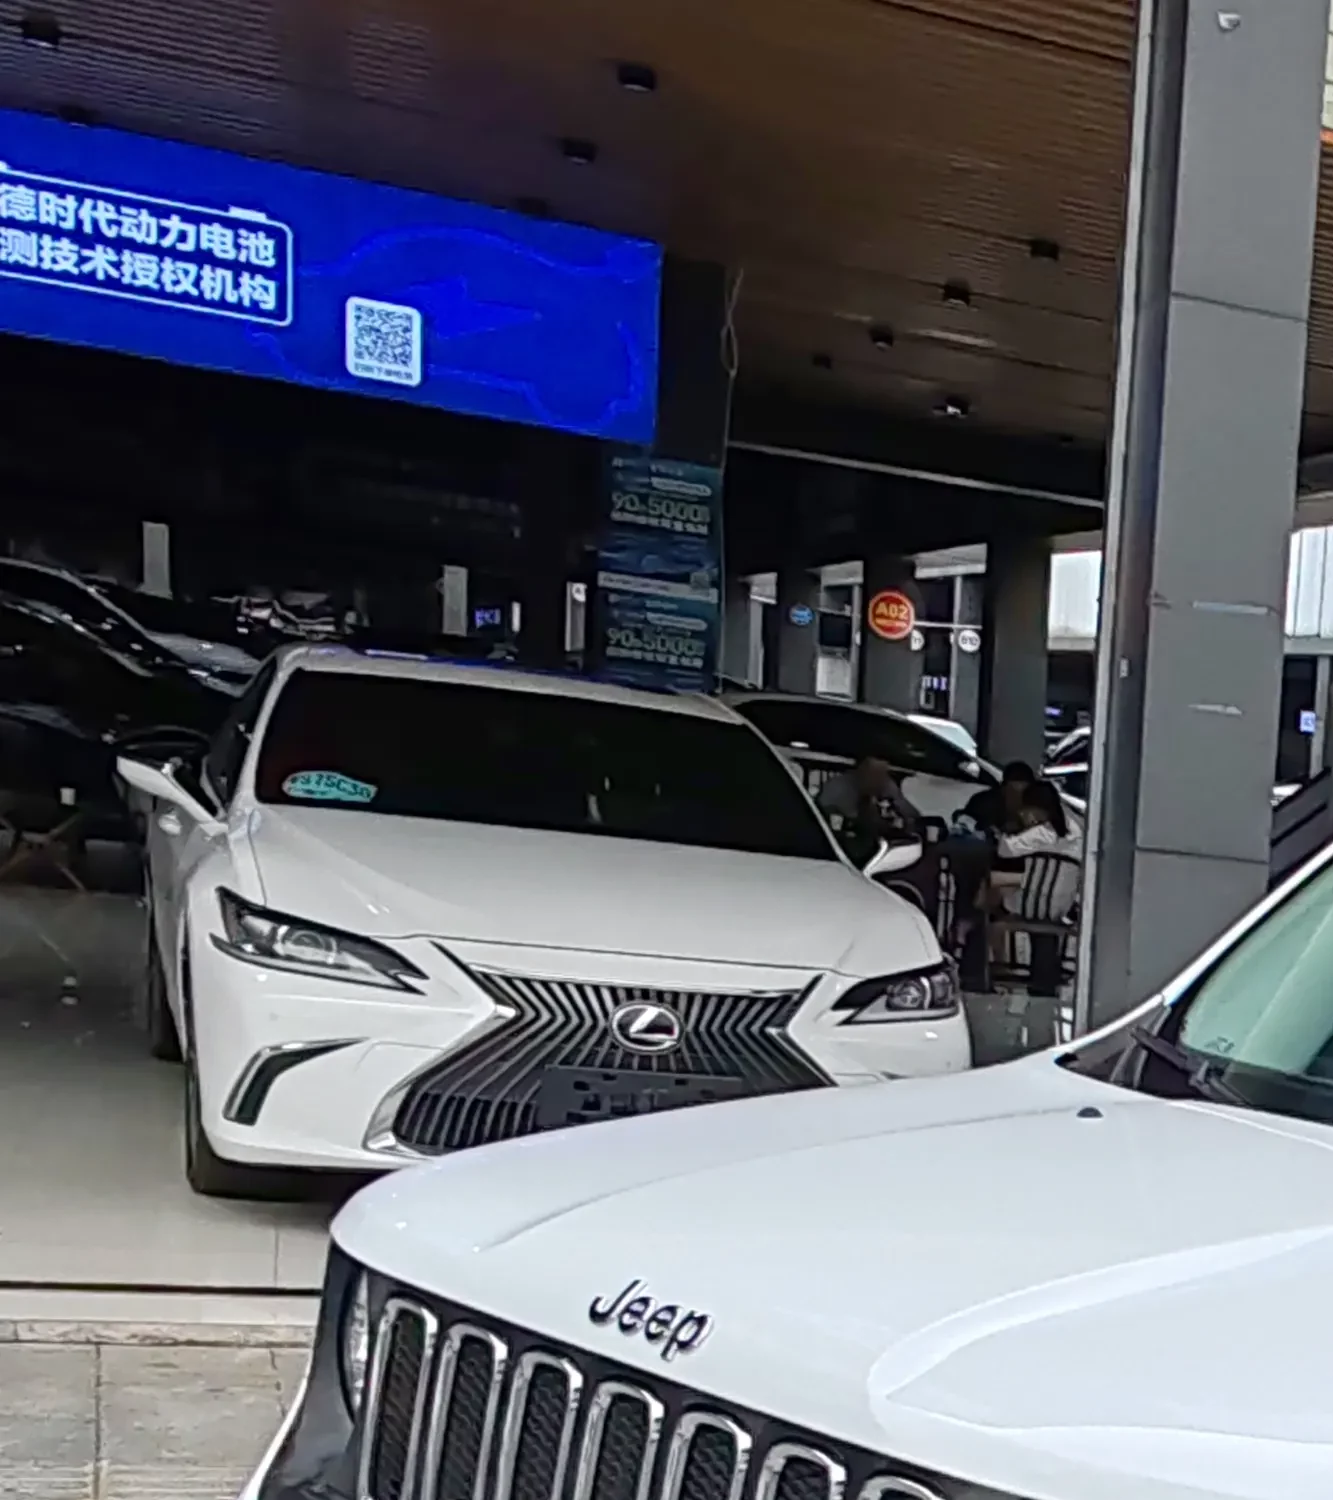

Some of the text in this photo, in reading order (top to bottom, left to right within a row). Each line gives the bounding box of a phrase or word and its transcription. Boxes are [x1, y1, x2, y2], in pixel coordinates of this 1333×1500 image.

[0, 183, 276, 267] 德时代动力电池
[876, 602, 908, 619] A02
[589, 1278, 714, 1362] Jeep
